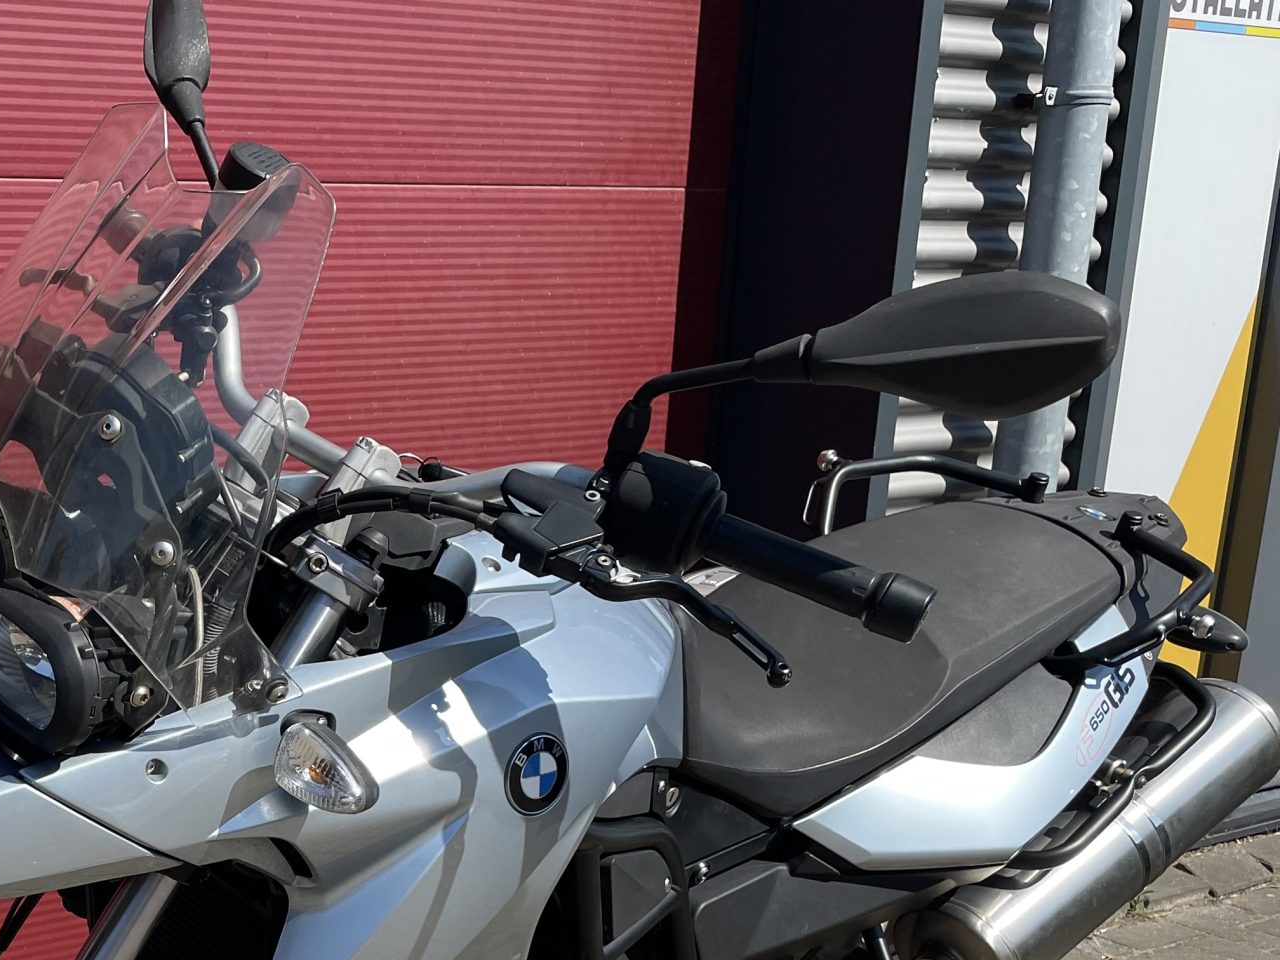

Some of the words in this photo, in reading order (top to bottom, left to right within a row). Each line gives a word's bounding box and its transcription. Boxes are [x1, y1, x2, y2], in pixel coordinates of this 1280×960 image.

[1171, 0, 1280, 21] ALLAT
[1089, 700, 1110, 731] 650
[515, 738, 562, 767] BMW
